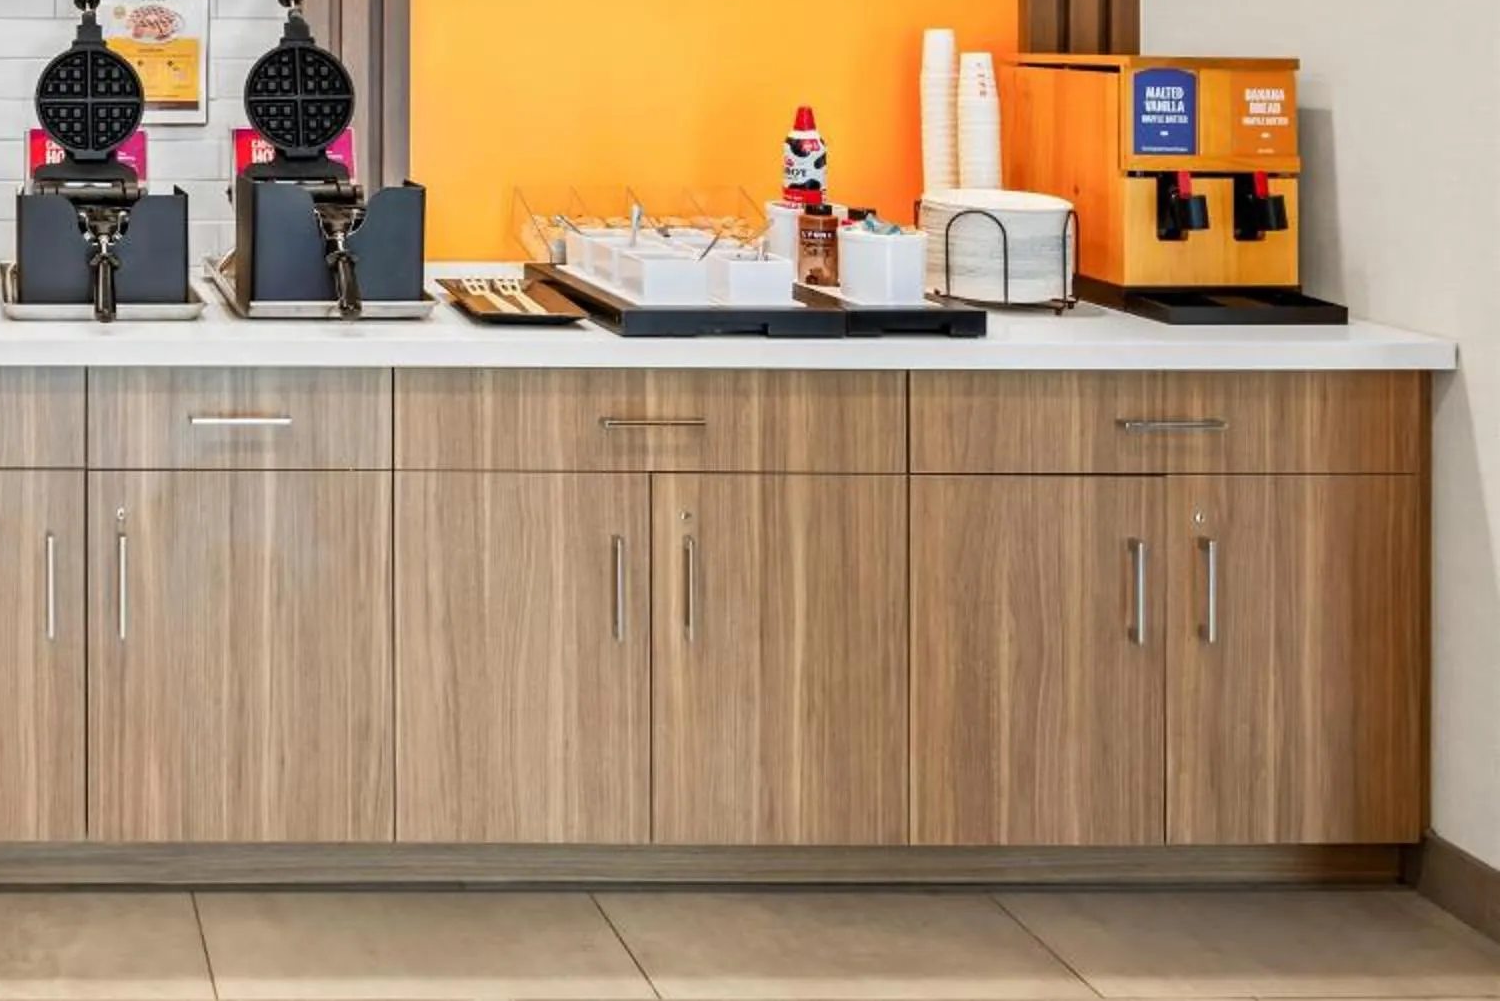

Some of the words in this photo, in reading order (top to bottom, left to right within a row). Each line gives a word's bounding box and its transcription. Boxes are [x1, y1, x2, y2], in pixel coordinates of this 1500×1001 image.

[1145, 86, 1185, 100] MALTED
[1245, 88, 1285, 101] BANANA
[1143, 100, 1186, 113] VANILLA
